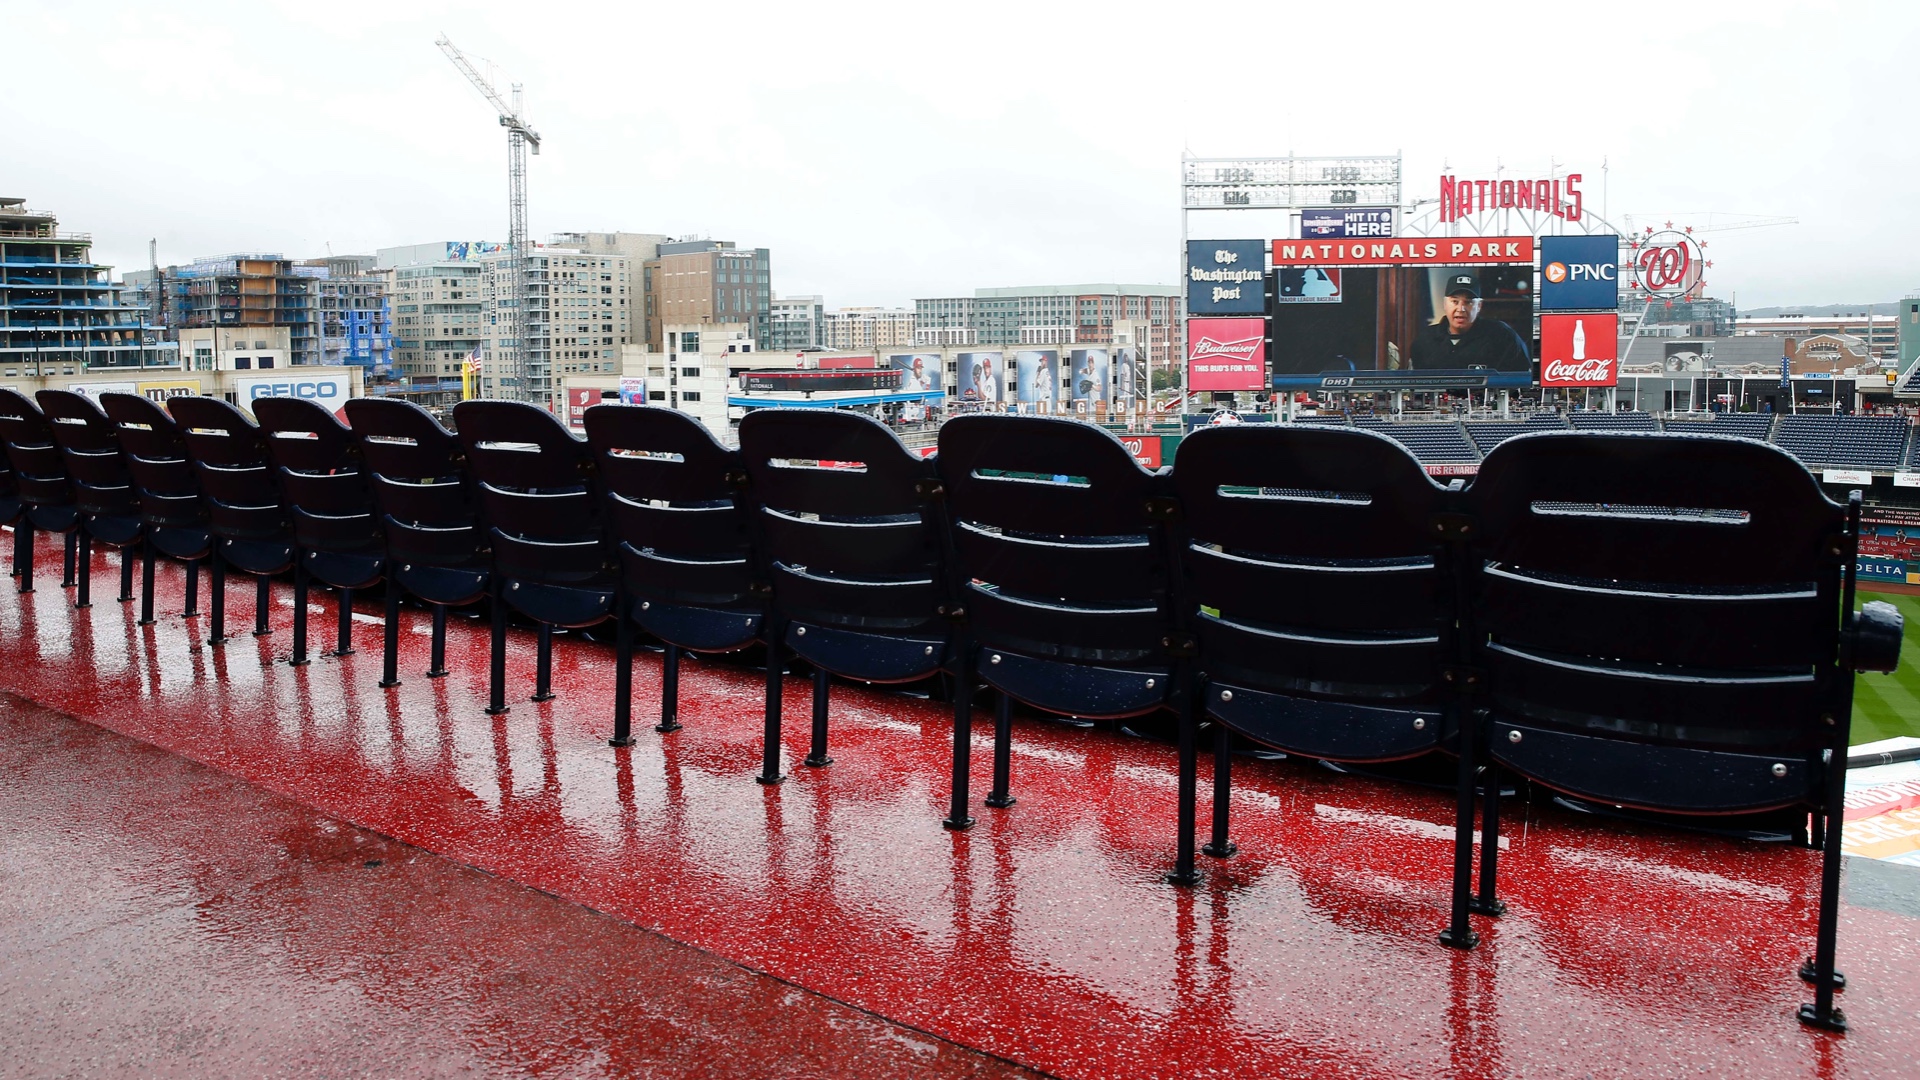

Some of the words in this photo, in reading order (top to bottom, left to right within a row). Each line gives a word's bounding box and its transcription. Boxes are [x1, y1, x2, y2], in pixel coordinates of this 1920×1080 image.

[1440, 174, 1581, 222] NATIONALS
[1345, 213, 1366, 222] HIT
[1367, 213, 1379, 222] IT
[1345, 223, 1390, 236] HERE
[1215, 250, 1238, 265] The
[1282, 243, 1437, 260] NATIONALS
[1452, 242, 1520, 257] PARK
[1568, 263, 1615, 281] PNC
[1639, 241, 1687, 290] W
[1190, 266, 1263, 284] Washington
[1212, 287, 1242, 304] Post
[1195, 341, 1255, 354] Budweiser
[1194, 364, 1209, 372] THIS
[1210, 364, 1230, 372] BUD'S
[1231, 364, 1243, 372] FOR
[1244, 364, 1260, 372] YOU.
[1544, 359, 1613, 382] Coca-Cola
[1326, 378, 1347, 386] DHS
[251, 382, 337, 401] GEICO
[998, 402, 1085, 414] SWING
[1115, 401, 1164, 413] BIG
[1430, 466, 1442, 475] ITS
[1443, 466, 1480, 475] REWARDS
[1856, 564, 1902, 575] DELTA
